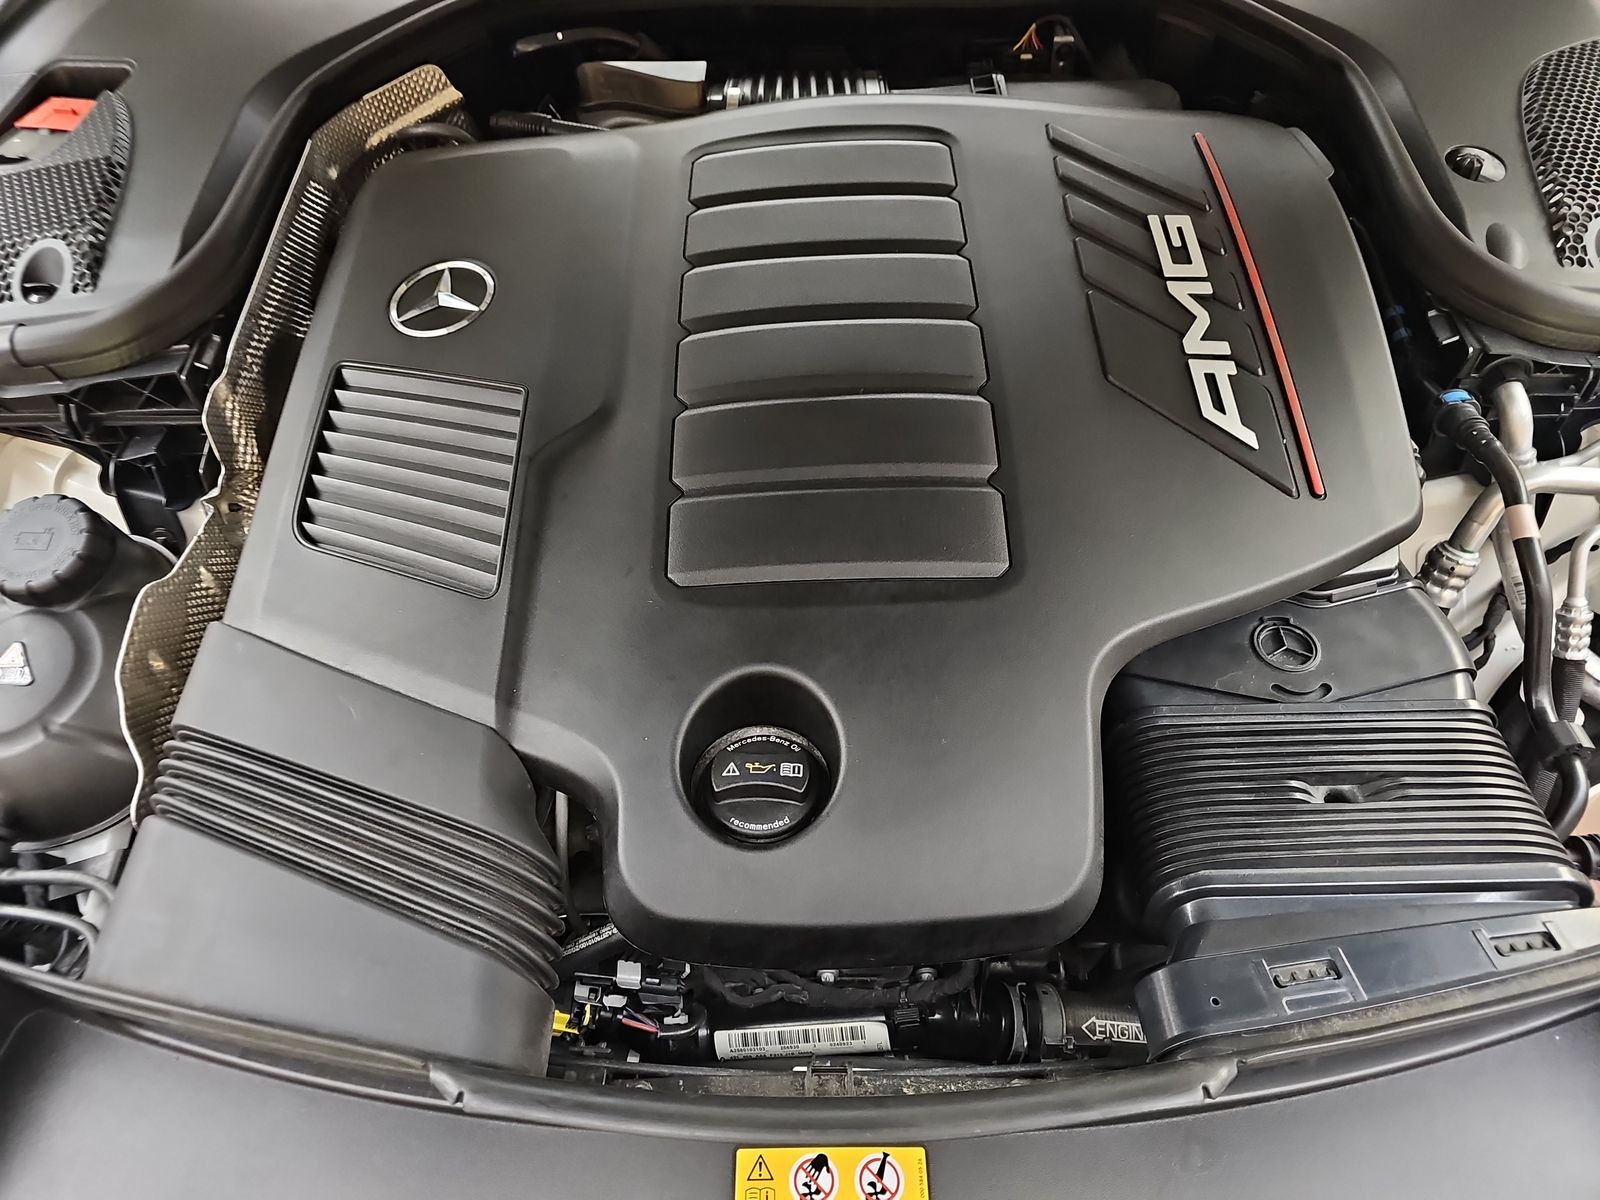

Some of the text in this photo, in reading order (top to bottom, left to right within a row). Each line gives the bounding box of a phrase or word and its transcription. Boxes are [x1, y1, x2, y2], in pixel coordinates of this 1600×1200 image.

[1147, 214, 1260, 450] AMG
[726, 735, 802, 753] Mercedes-Benz Oil
[729, 816, 791, 831] recommended
[1095, 1021, 1147, 1041] ENGIN
